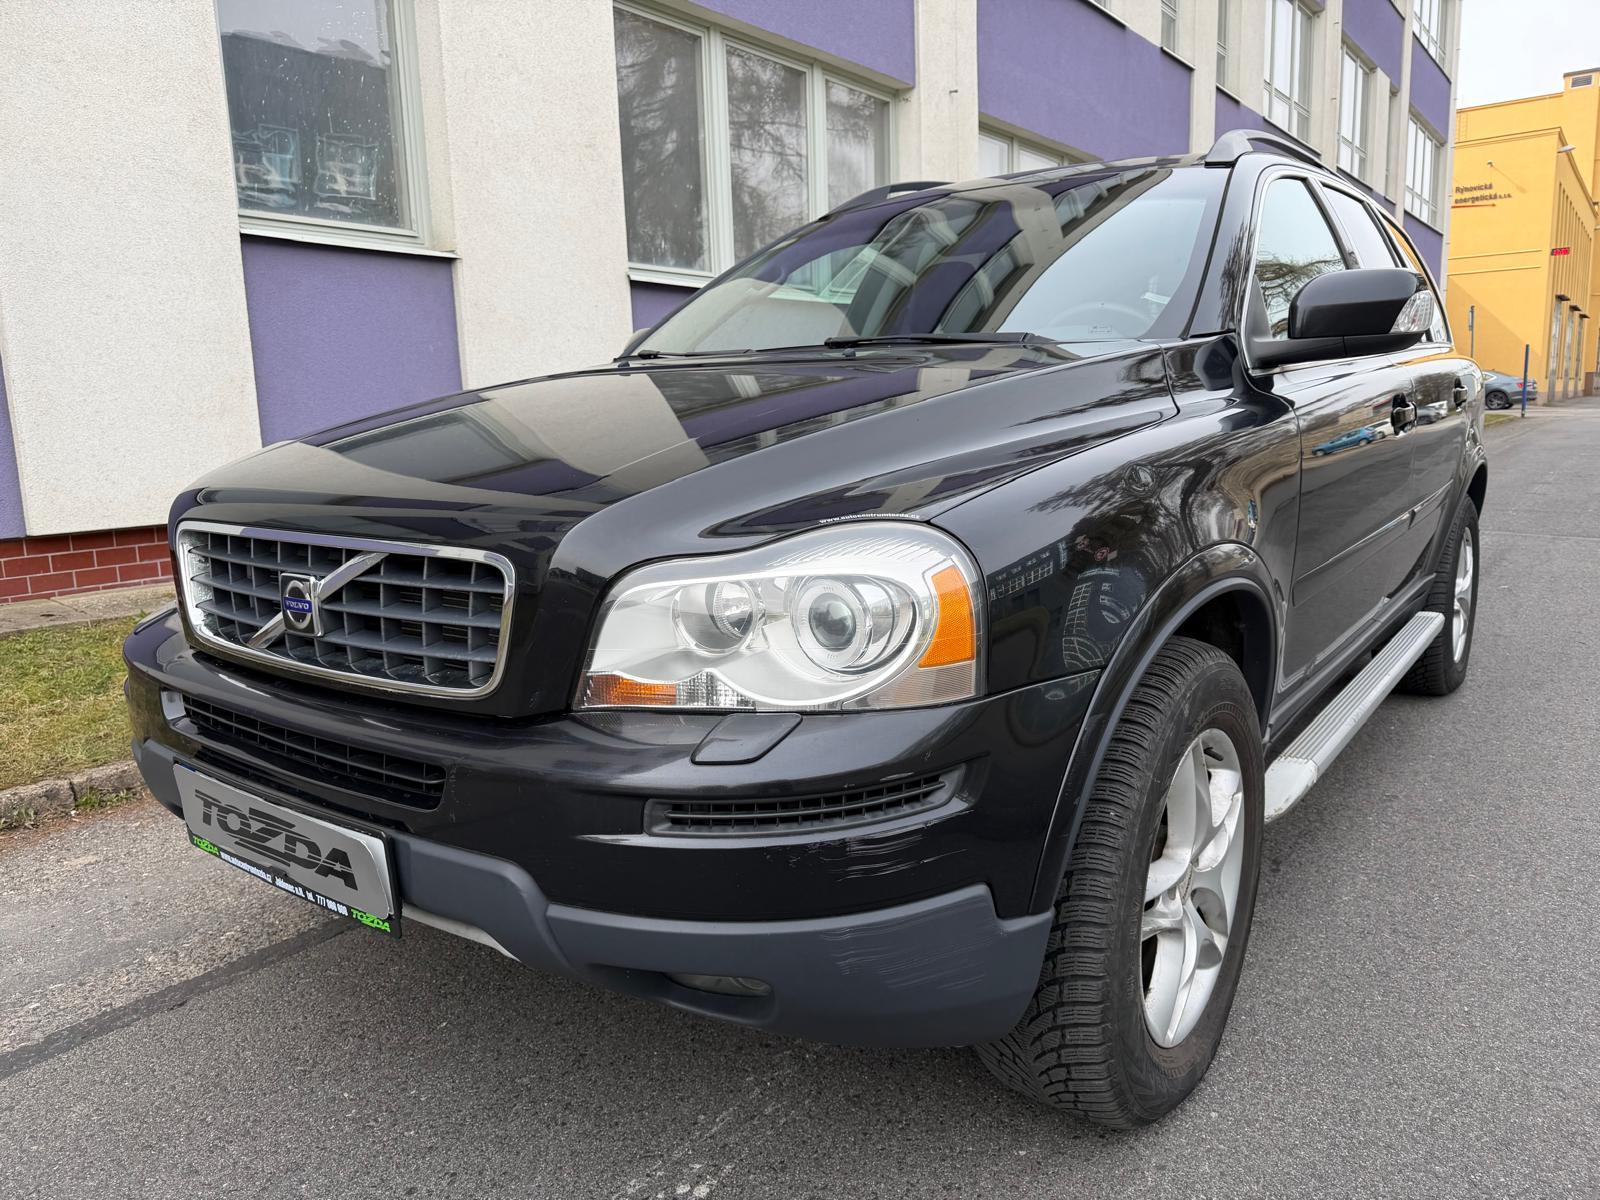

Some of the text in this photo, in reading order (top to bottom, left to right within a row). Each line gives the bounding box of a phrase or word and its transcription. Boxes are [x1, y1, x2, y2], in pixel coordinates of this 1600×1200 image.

[286, 600, 309, 610] VOLVO
[192, 836, 220, 856] TOZDA
[194, 788, 359, 891] TOZDA
[350, 908, 391, 933] TOZDA
